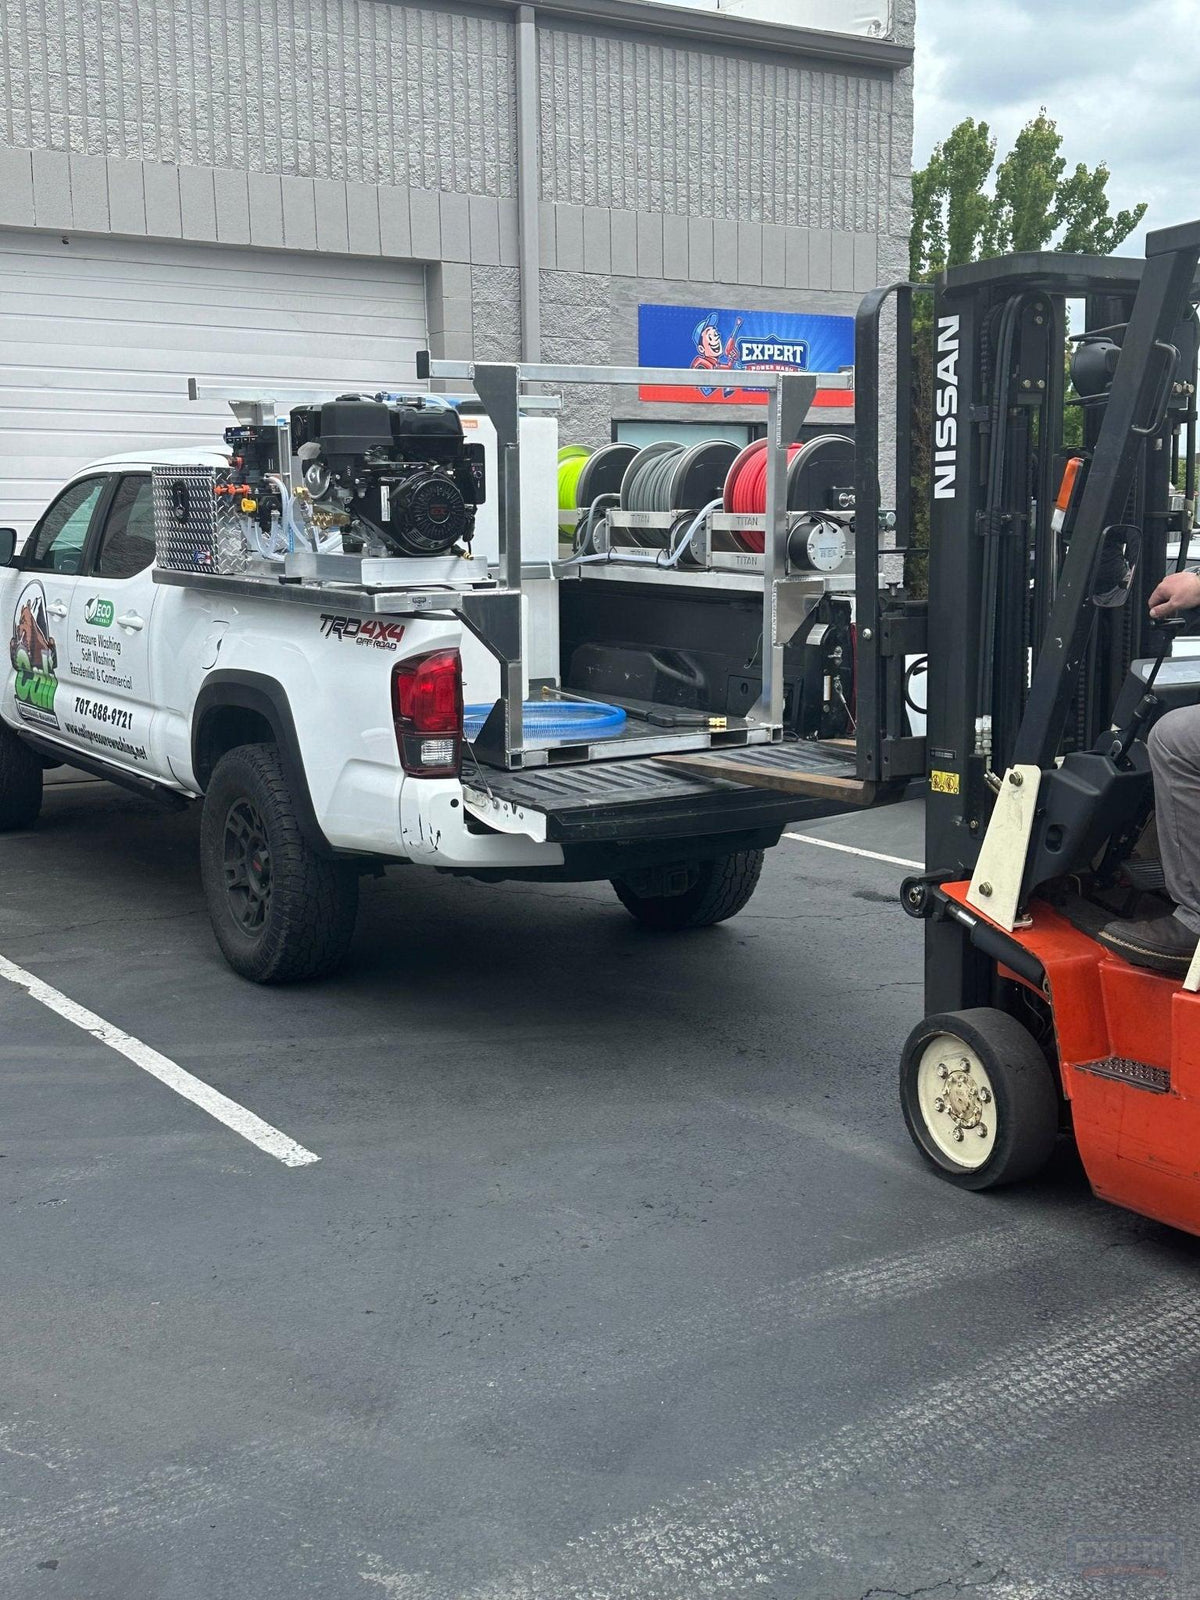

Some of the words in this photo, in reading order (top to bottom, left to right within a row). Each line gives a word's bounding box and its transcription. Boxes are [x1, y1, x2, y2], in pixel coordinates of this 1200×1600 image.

[741, 343, 804, 364] EXPERT
[934, 314, 960, 499] NISSAN
[630, 514, 650, 523] TITAN
[735, 516, 758, 526] TITAN
[735, 556, 758, 566] TITAN
[96, 603, 112, 618] ECO
[319, 613, 361, 641] TRD
[75, 629, 97, 646] Pressure
[97, 635, 121, 655] Washing
[356, 637, 373, 647] OFF
[373, 640, 398, 651] ROAD
[81, 647, 91, 661] Soft
[92, 650, 116, 671] Washing
[69, 661, 96, 680] Residential
[96, 668, 101, 682] &
[101, 669, 133, 690] Commercial
[75, 696, 133, 730] 707-888-9721
